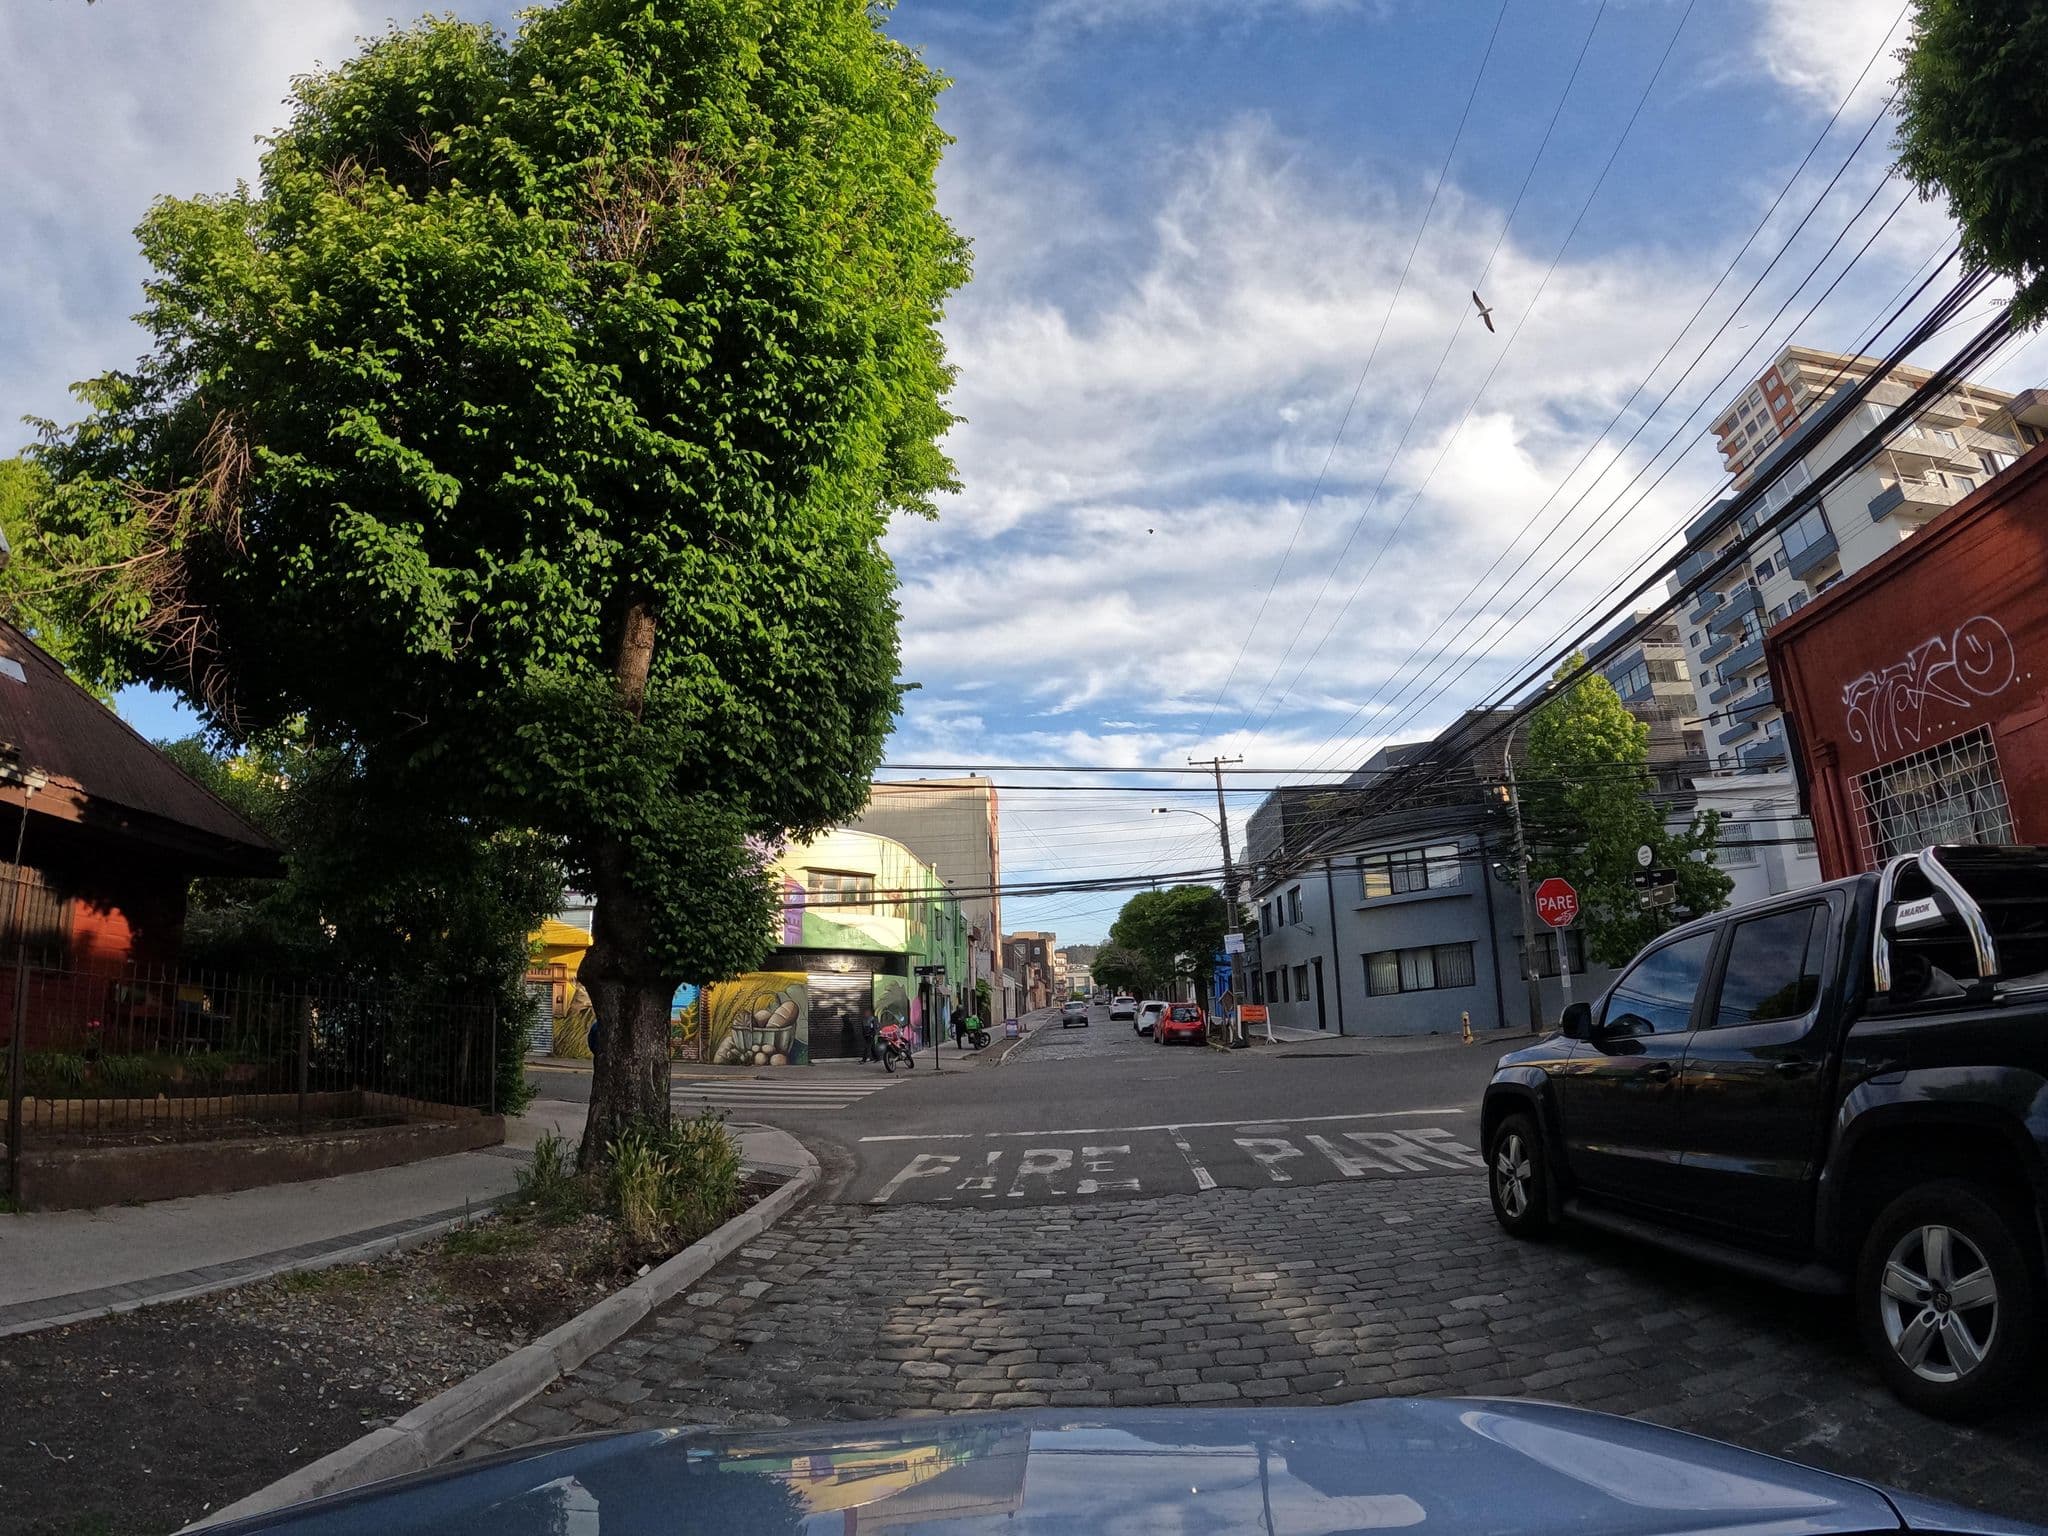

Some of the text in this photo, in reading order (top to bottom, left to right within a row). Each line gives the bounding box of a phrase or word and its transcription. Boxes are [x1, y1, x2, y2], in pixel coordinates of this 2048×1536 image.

[1538, 895, 1574, 911] PARE
[1899, 904, 1930, 917] AMAROK
[1233, 1127, 1488, 1181] PARE
